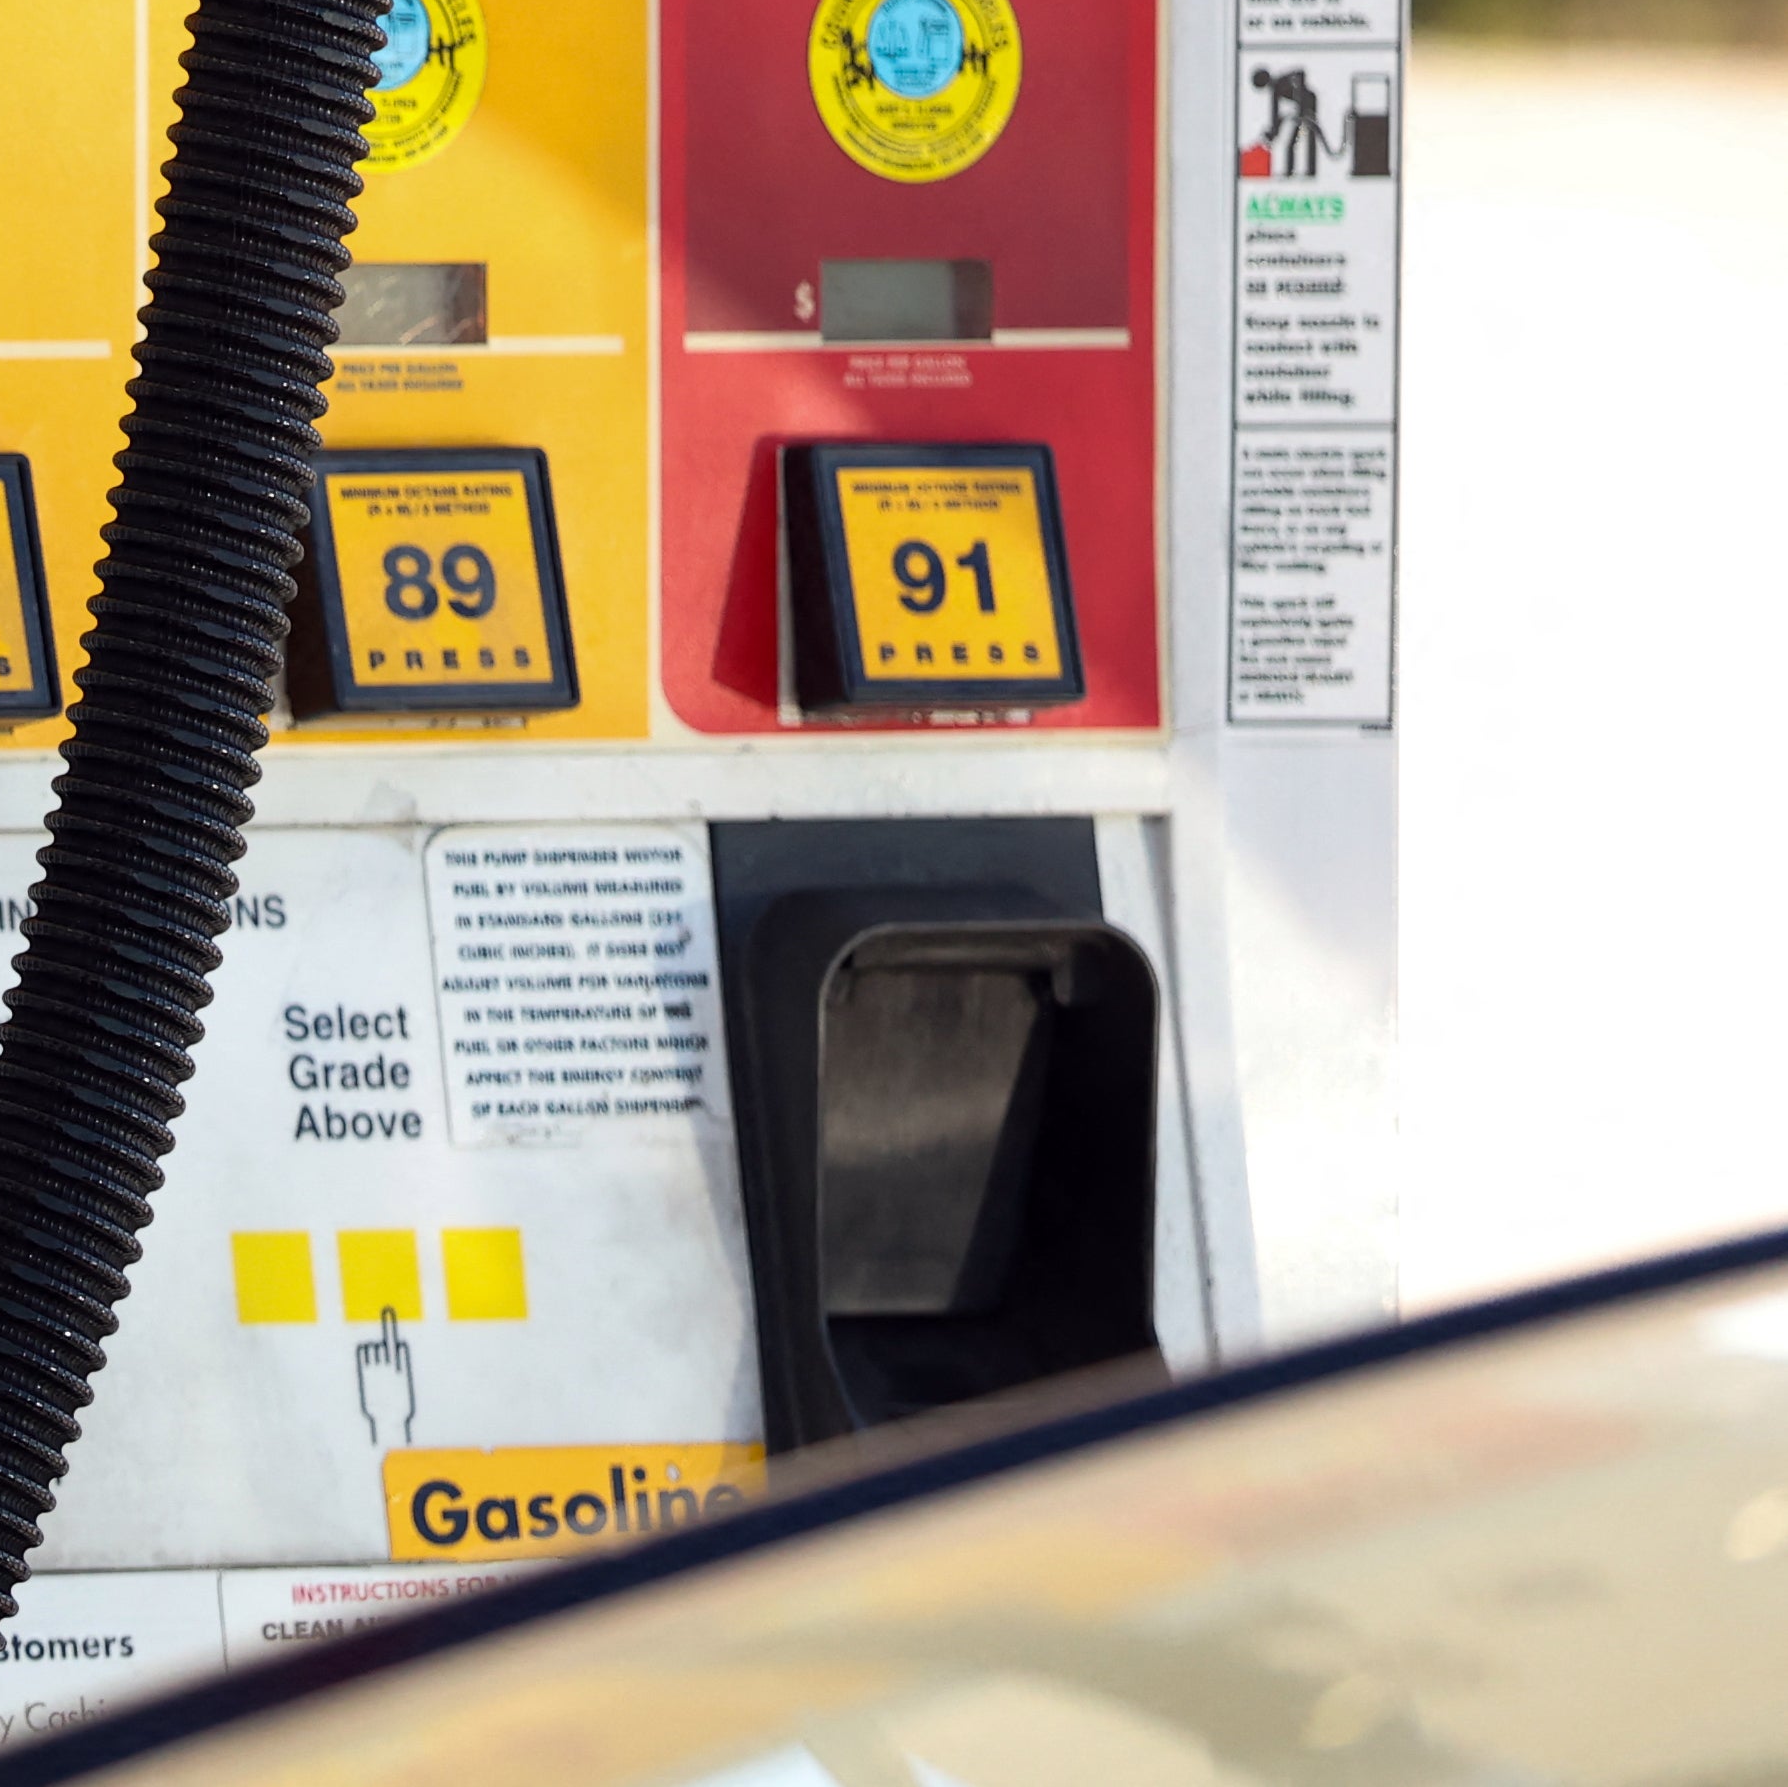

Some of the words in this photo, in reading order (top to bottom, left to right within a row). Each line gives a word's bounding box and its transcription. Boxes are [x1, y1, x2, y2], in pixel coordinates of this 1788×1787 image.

[1248, 195, 1345, 218] ALWAYS
[795, 281, 816, 321] $
[382, 543, 496, 620] 89
[892, 540, 996, 614] 91
[370, 648, 531, 671] PRESS
[880, 642, 1041, 665] PRESS
[483, 849, 527, 864] PUMP
[454, 880, 489, 897] FUEL
[524, 879, 588, 895] VOLUME
[285, 1004, 410, 1043] Select
[288, 1054, 410, 1091] Grade
[294, 1106, 422, 1141] Above
[411, 1463, 743, 1546] Gasoline
[291, 1577, 449, 1605] INSTRUCTIONS
[262, 1618, 345, 1642] CLEAN
